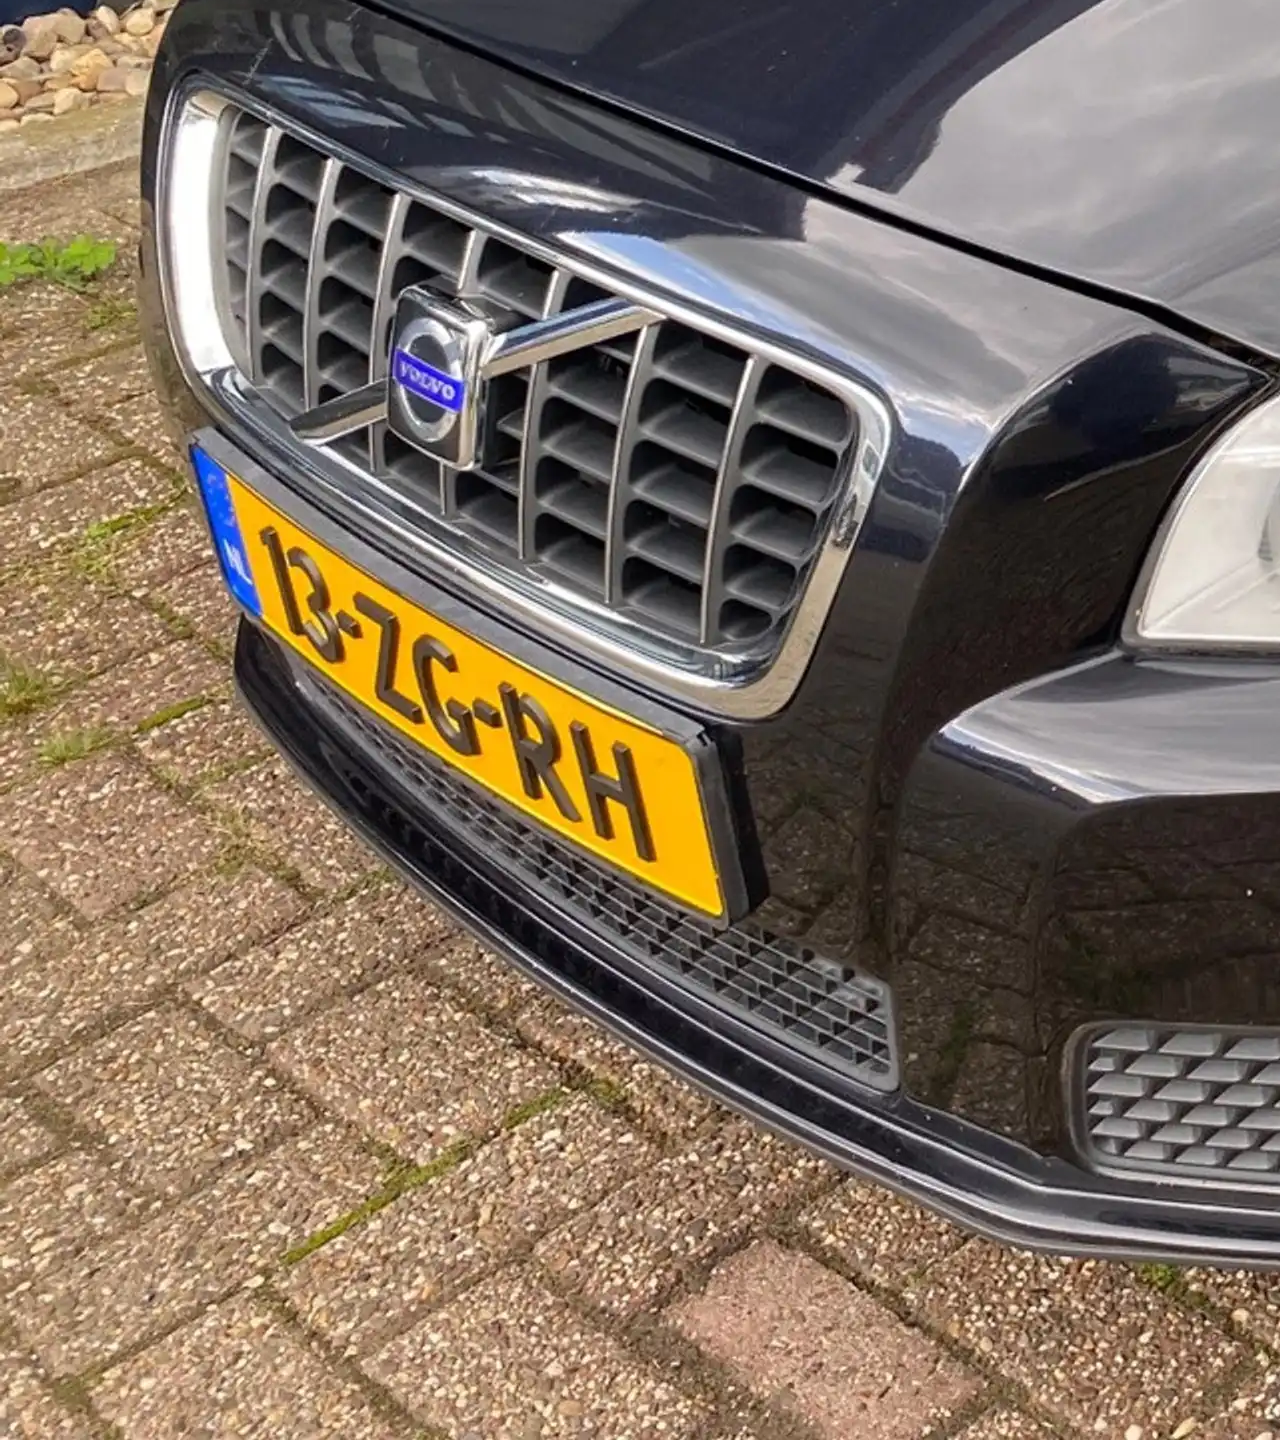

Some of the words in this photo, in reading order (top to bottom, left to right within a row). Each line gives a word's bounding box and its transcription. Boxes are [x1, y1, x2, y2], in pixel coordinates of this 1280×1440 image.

[399, 360, 457, 401] VOLVO
[223, 538, 253, 586] NL
[259, 525, 657, 863] 13-ZG-RH
